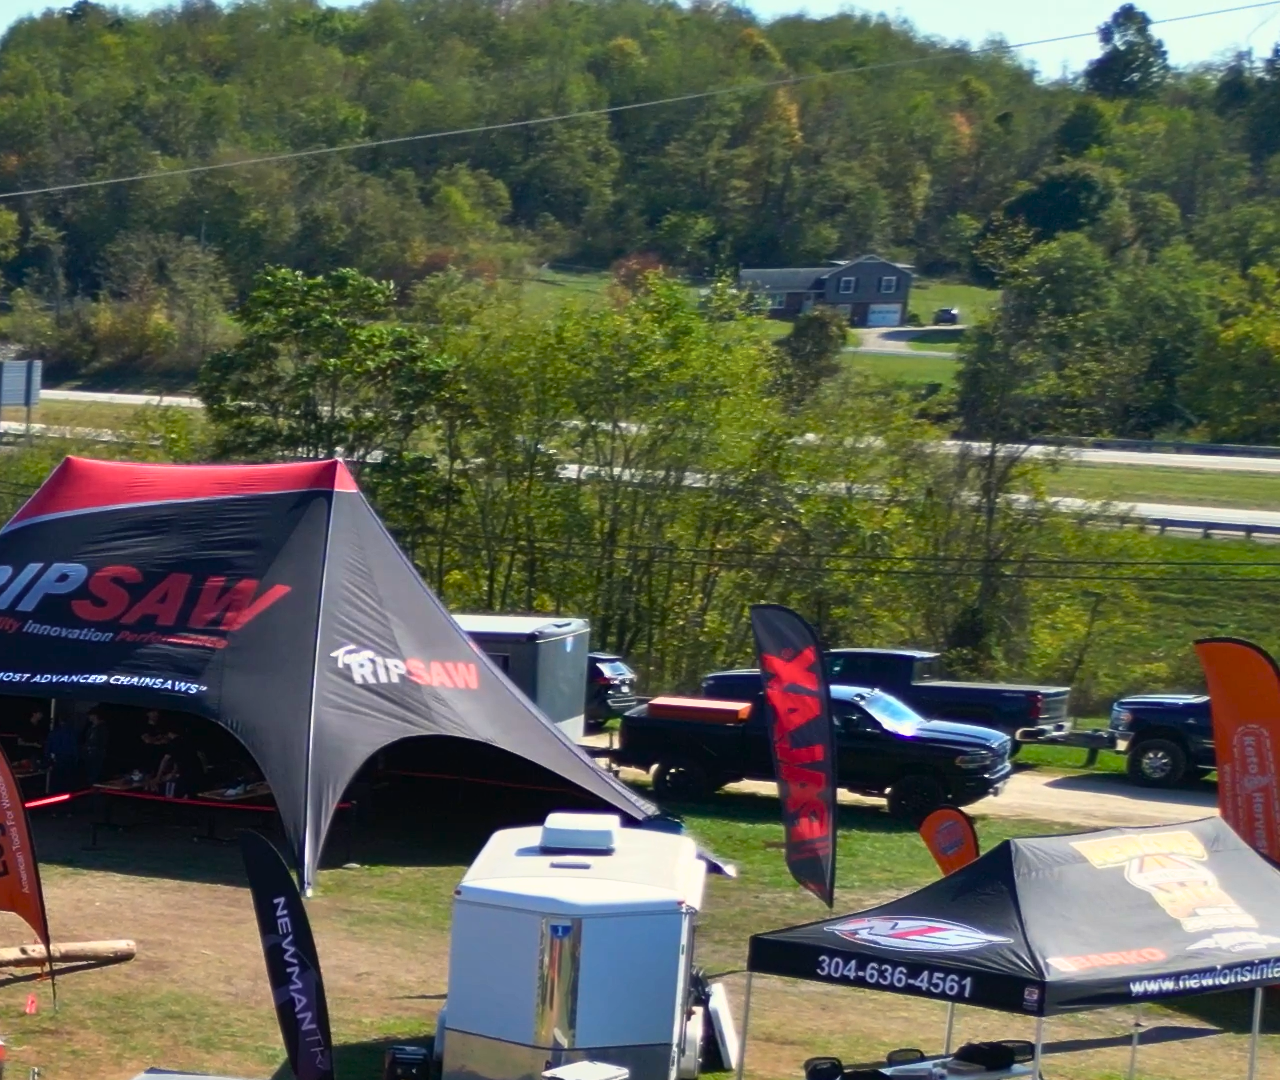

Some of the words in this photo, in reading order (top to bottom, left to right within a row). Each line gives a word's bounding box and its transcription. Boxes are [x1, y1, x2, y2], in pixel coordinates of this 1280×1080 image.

[32, 673, 108, 685] ADVANCED
[349, 656, 479, 690] RIPSAW
[7, 833, 21, 856] Tools
[13, 857, 30, 894] American
[1069, 947, 1167, 970] BARKO
[815, 954, 973, 998] 304-636-4561
